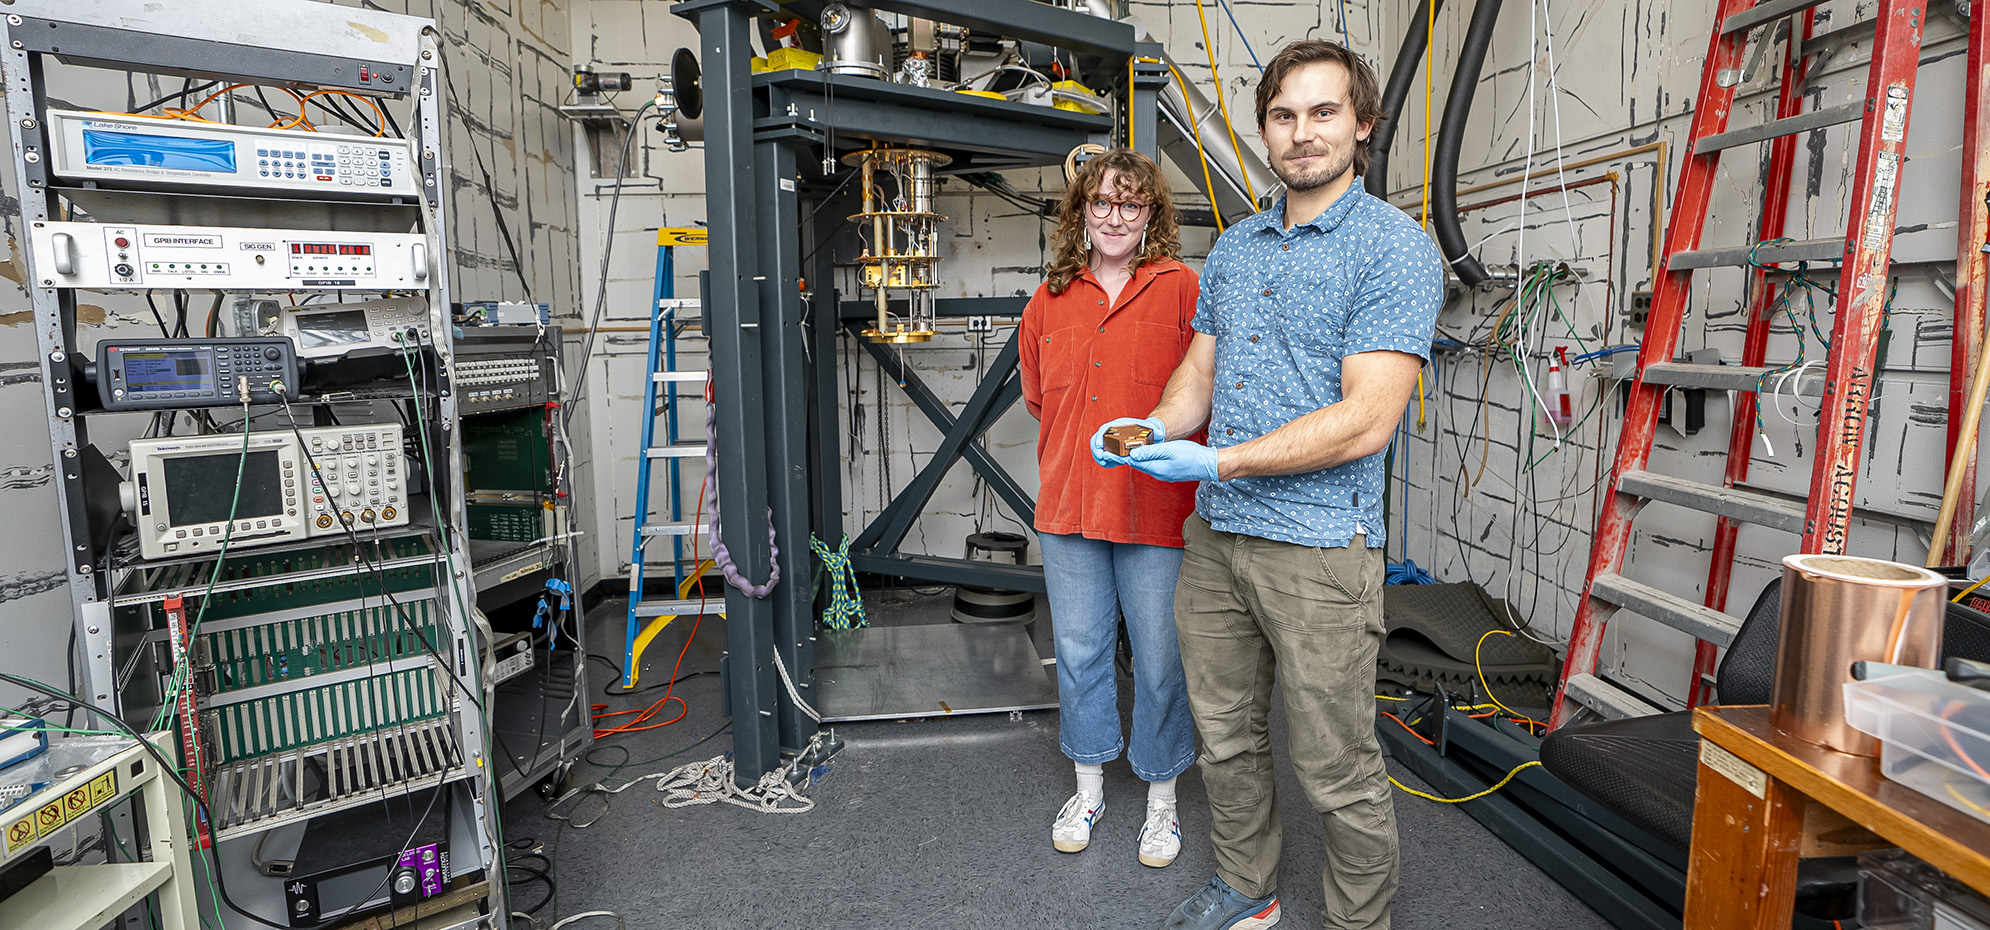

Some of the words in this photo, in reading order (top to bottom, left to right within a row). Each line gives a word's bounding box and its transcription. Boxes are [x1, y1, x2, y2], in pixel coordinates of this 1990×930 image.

[93, 121, 113, 129] Lake
[114, 123, 138, 131] Shore
[1842, 366, 1869, 448] ARROW
